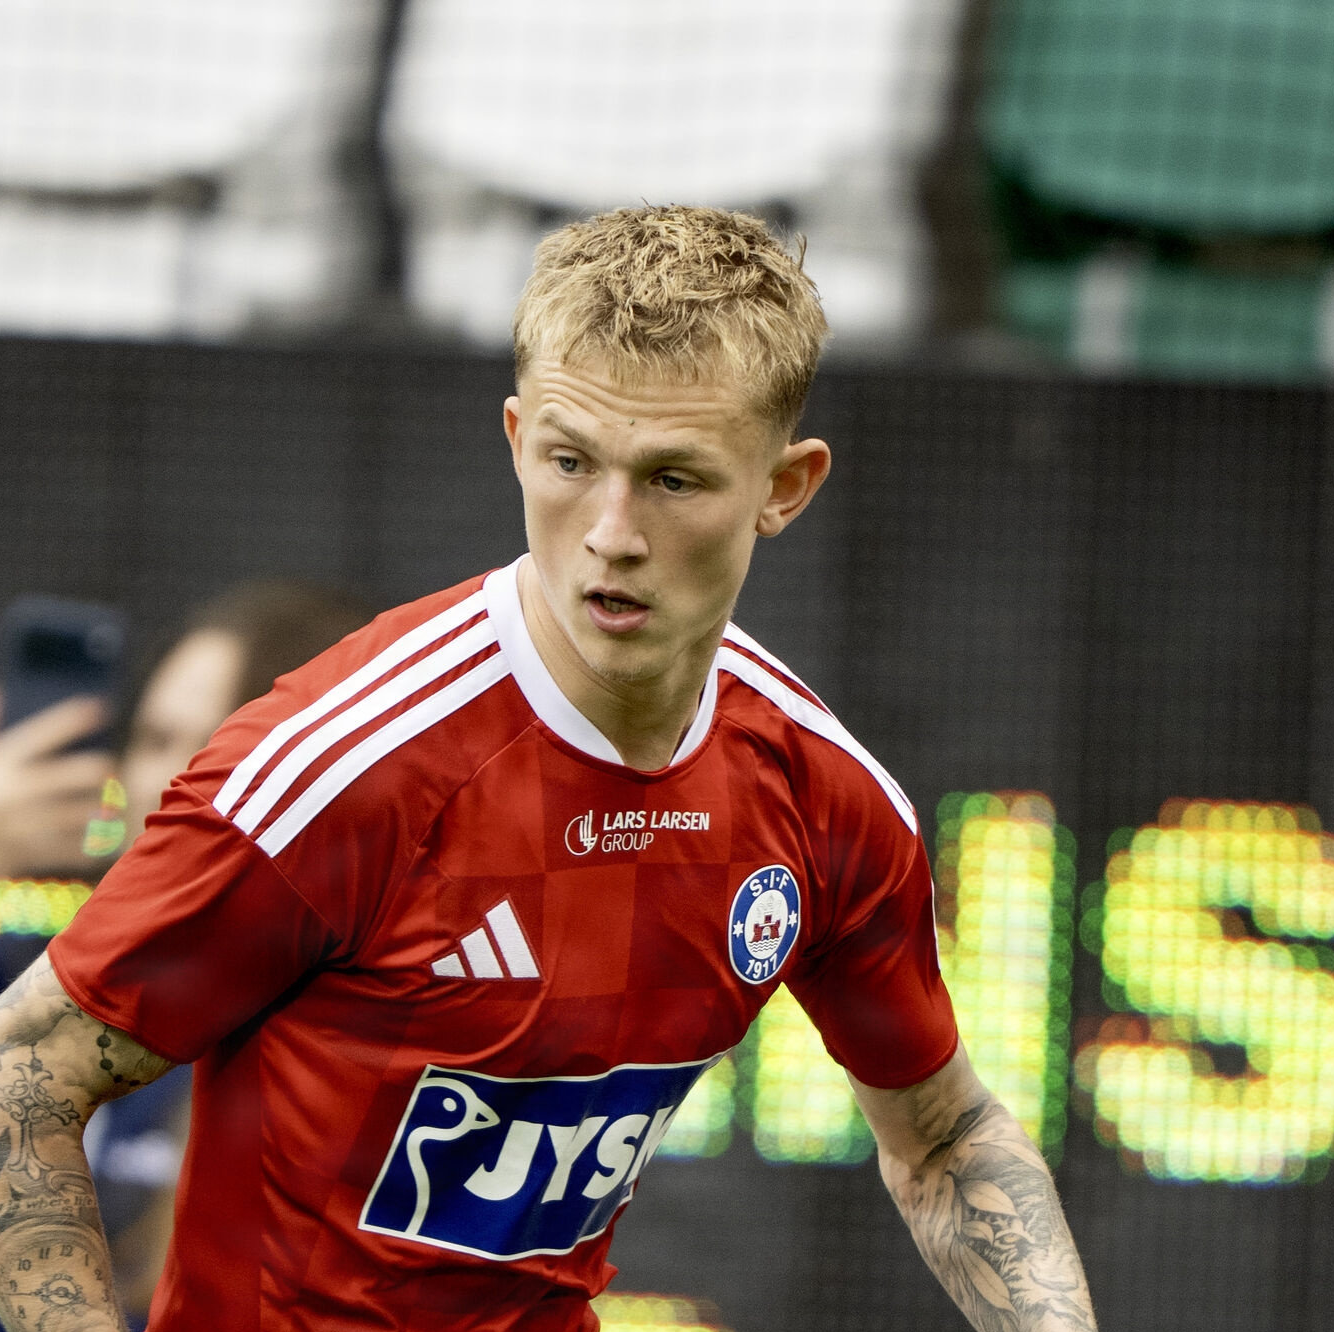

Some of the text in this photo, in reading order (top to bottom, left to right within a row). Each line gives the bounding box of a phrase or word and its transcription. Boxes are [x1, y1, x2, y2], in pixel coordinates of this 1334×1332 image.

[603, 810, 710, 831] LARS LARSEN
[601, 832, 655, 853] GROUP
[744, 952, 778, 979] 1917
[59, 1244, 74, 1257] 12
[17, 1258, 32, 1272] 10
